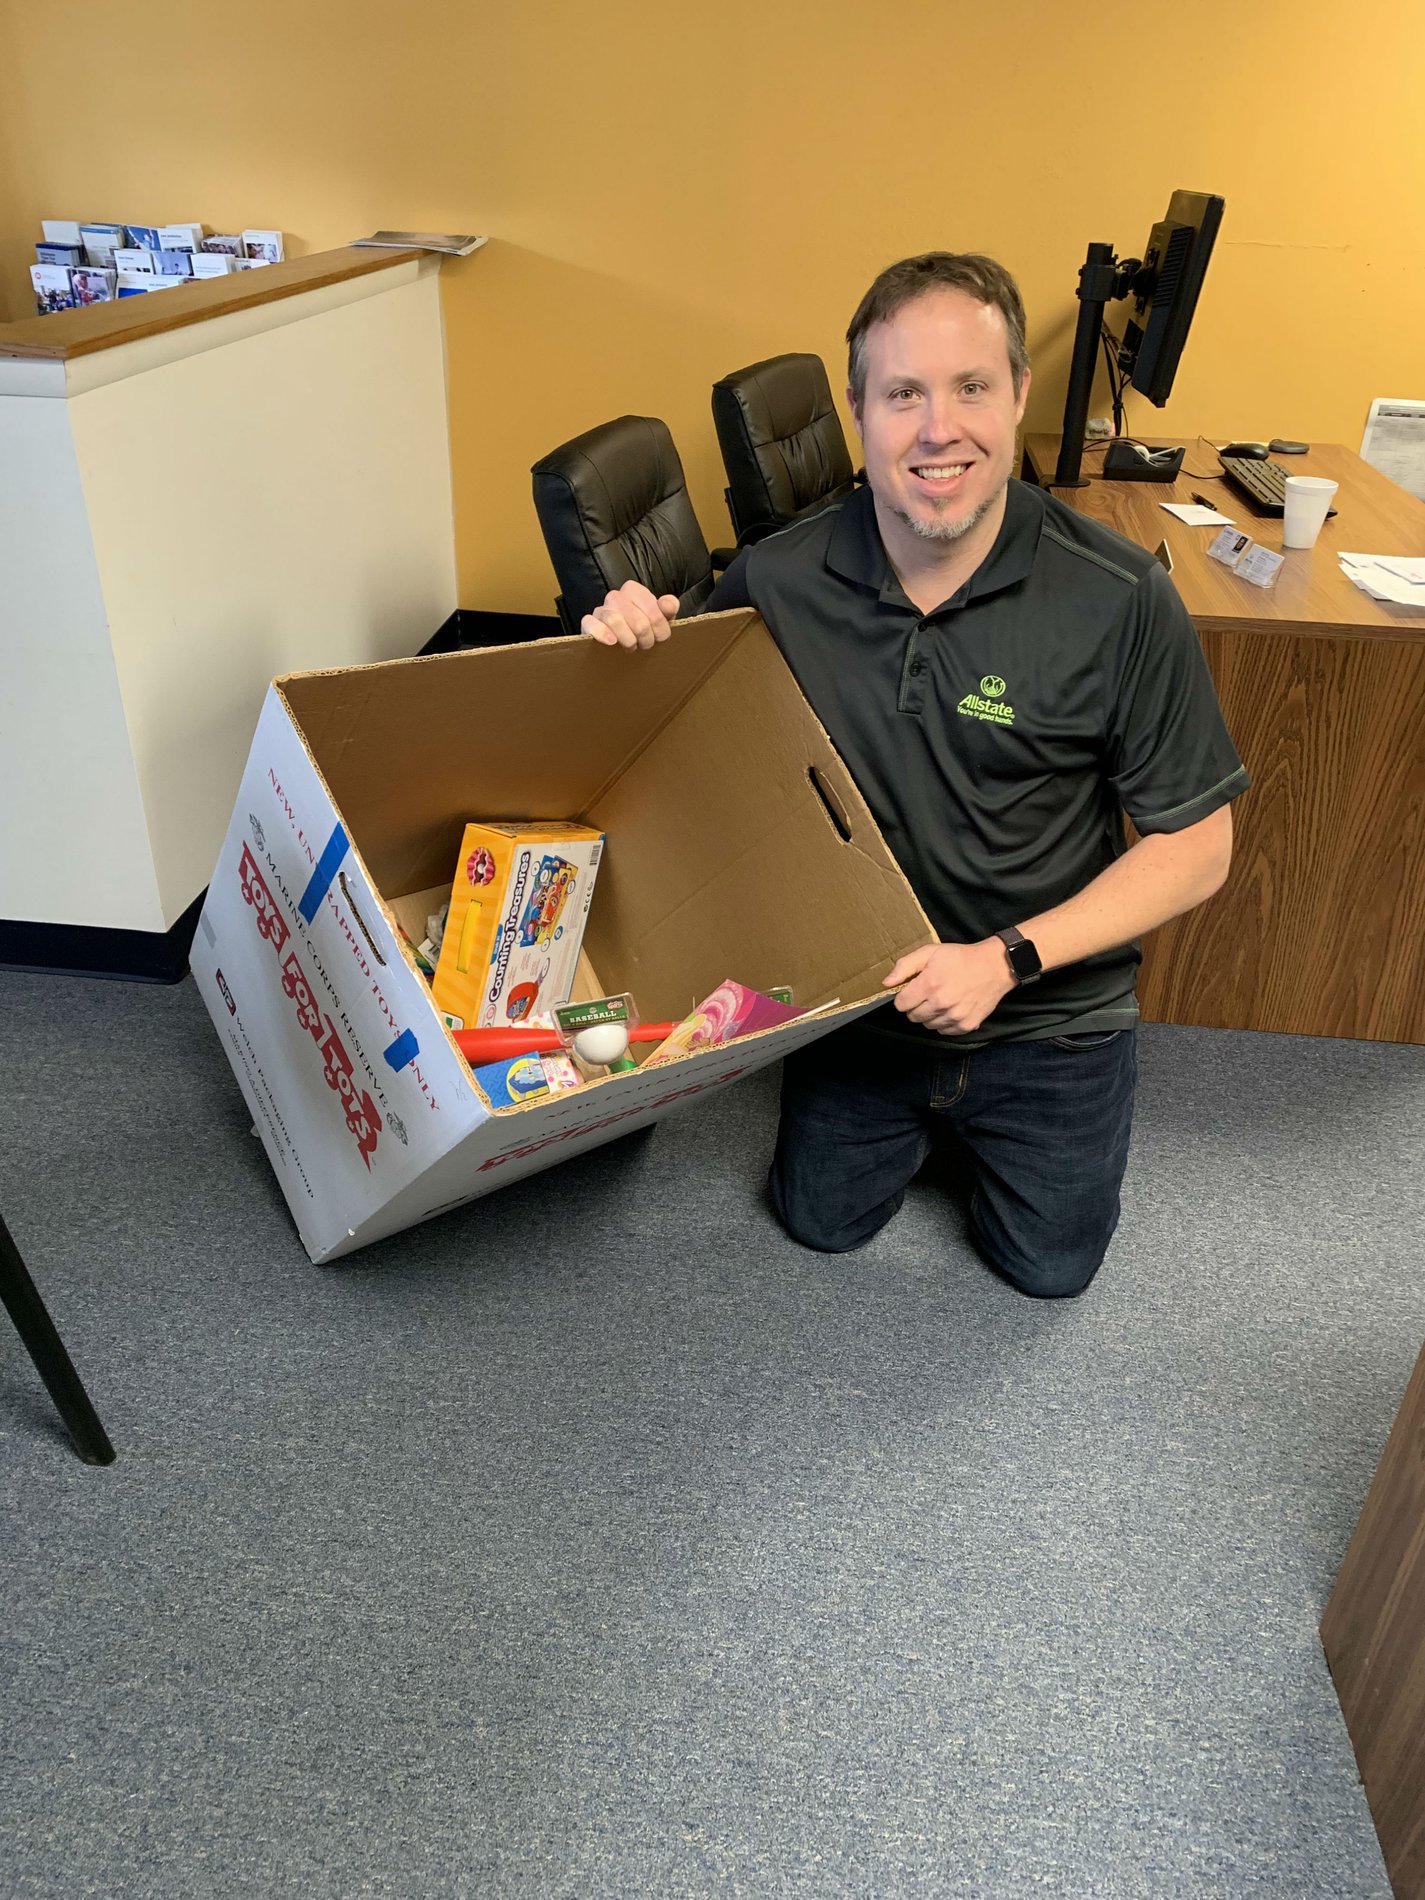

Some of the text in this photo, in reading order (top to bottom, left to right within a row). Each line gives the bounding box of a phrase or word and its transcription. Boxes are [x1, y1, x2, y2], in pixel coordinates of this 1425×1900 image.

[959, 694, 1013, 717] Allstate
[268, 768, 295, 829] NEW,
[244, 856, 371, 1140] TOYS FOR TOTS
[265, 852, 388, 1108] MARINE CORPS RESERVE
[489, 929, 516, 1002] Counting
[504, 851, 531, 937] Treasures
[569, 1010, 617, 1023] BASEBALL
[236, 1017, 314, 1199] Welch Packaging Group
